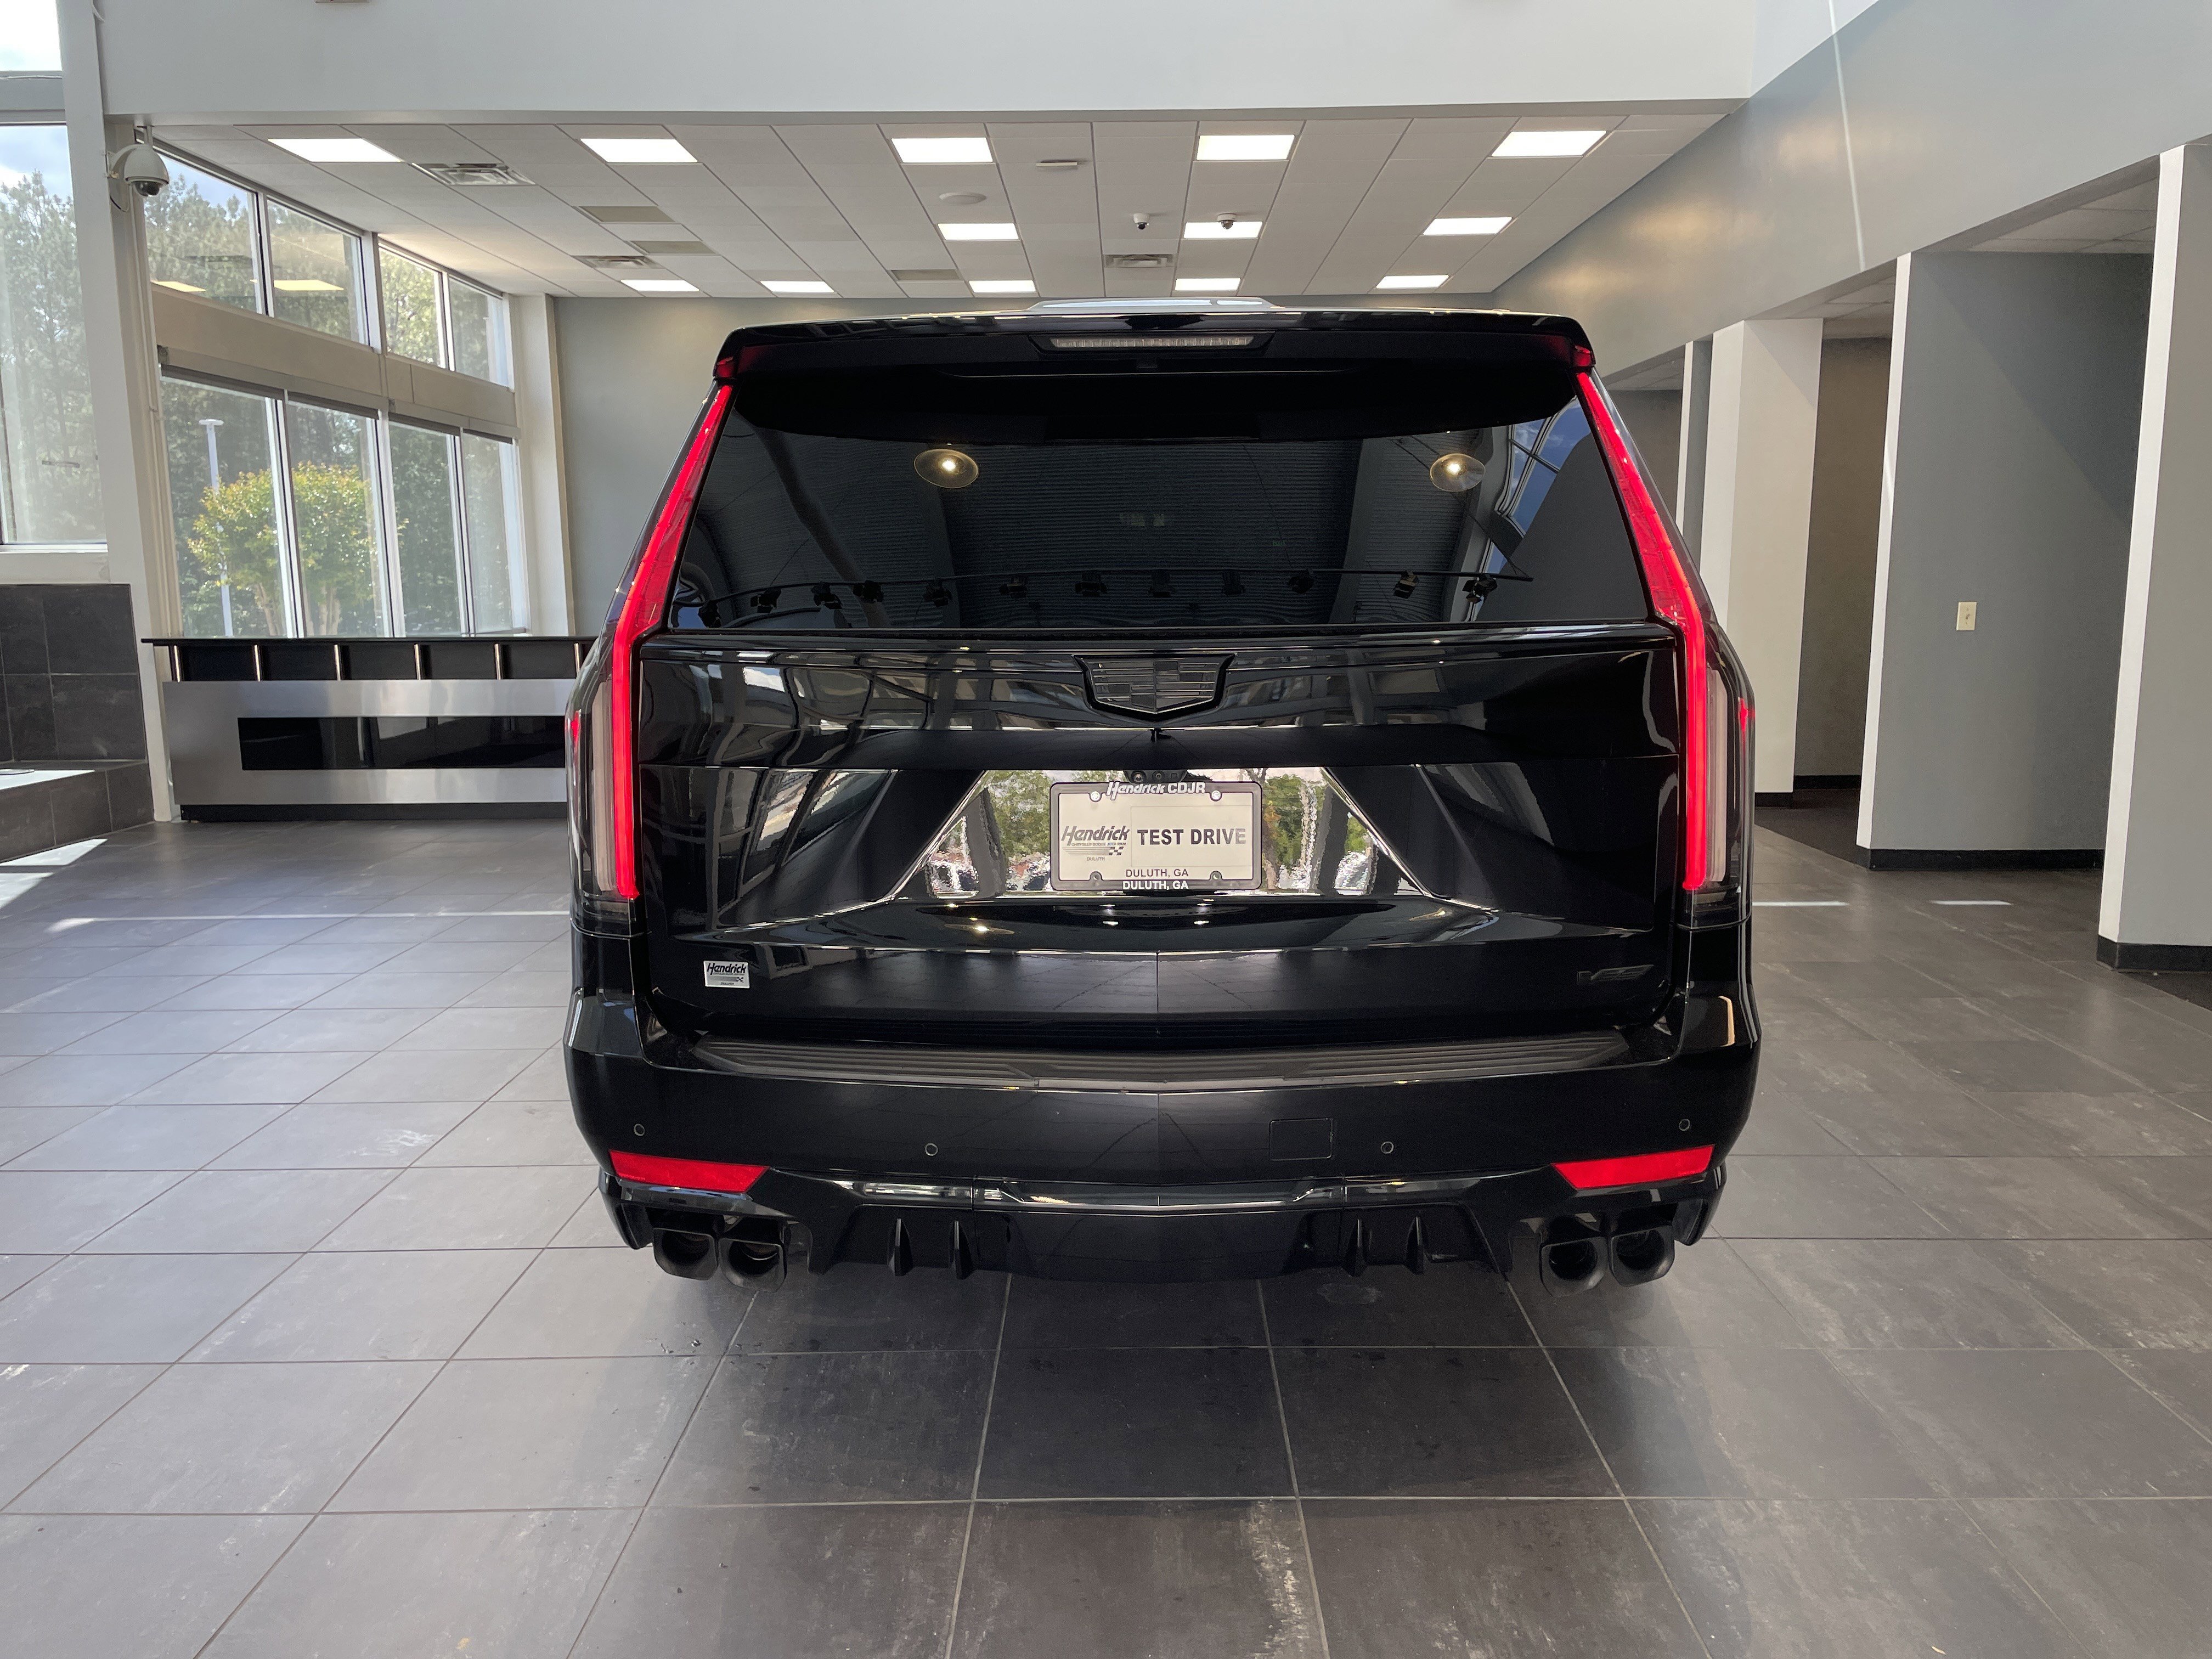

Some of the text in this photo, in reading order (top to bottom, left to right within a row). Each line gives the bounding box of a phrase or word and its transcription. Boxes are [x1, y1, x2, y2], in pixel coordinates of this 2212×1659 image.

[1106, 781, 1206, 800] Hendrick CDJR
[1061, 825, 1130, 845] Hendrick
[1137, 828, 1246, 845] TEST DRIVE
[1125, 868, 1189, 878] DULUTH, GA
[1122, 880, 1189, 890] DULUTH, GA
[707, 963, 747, 975] Hendrick
